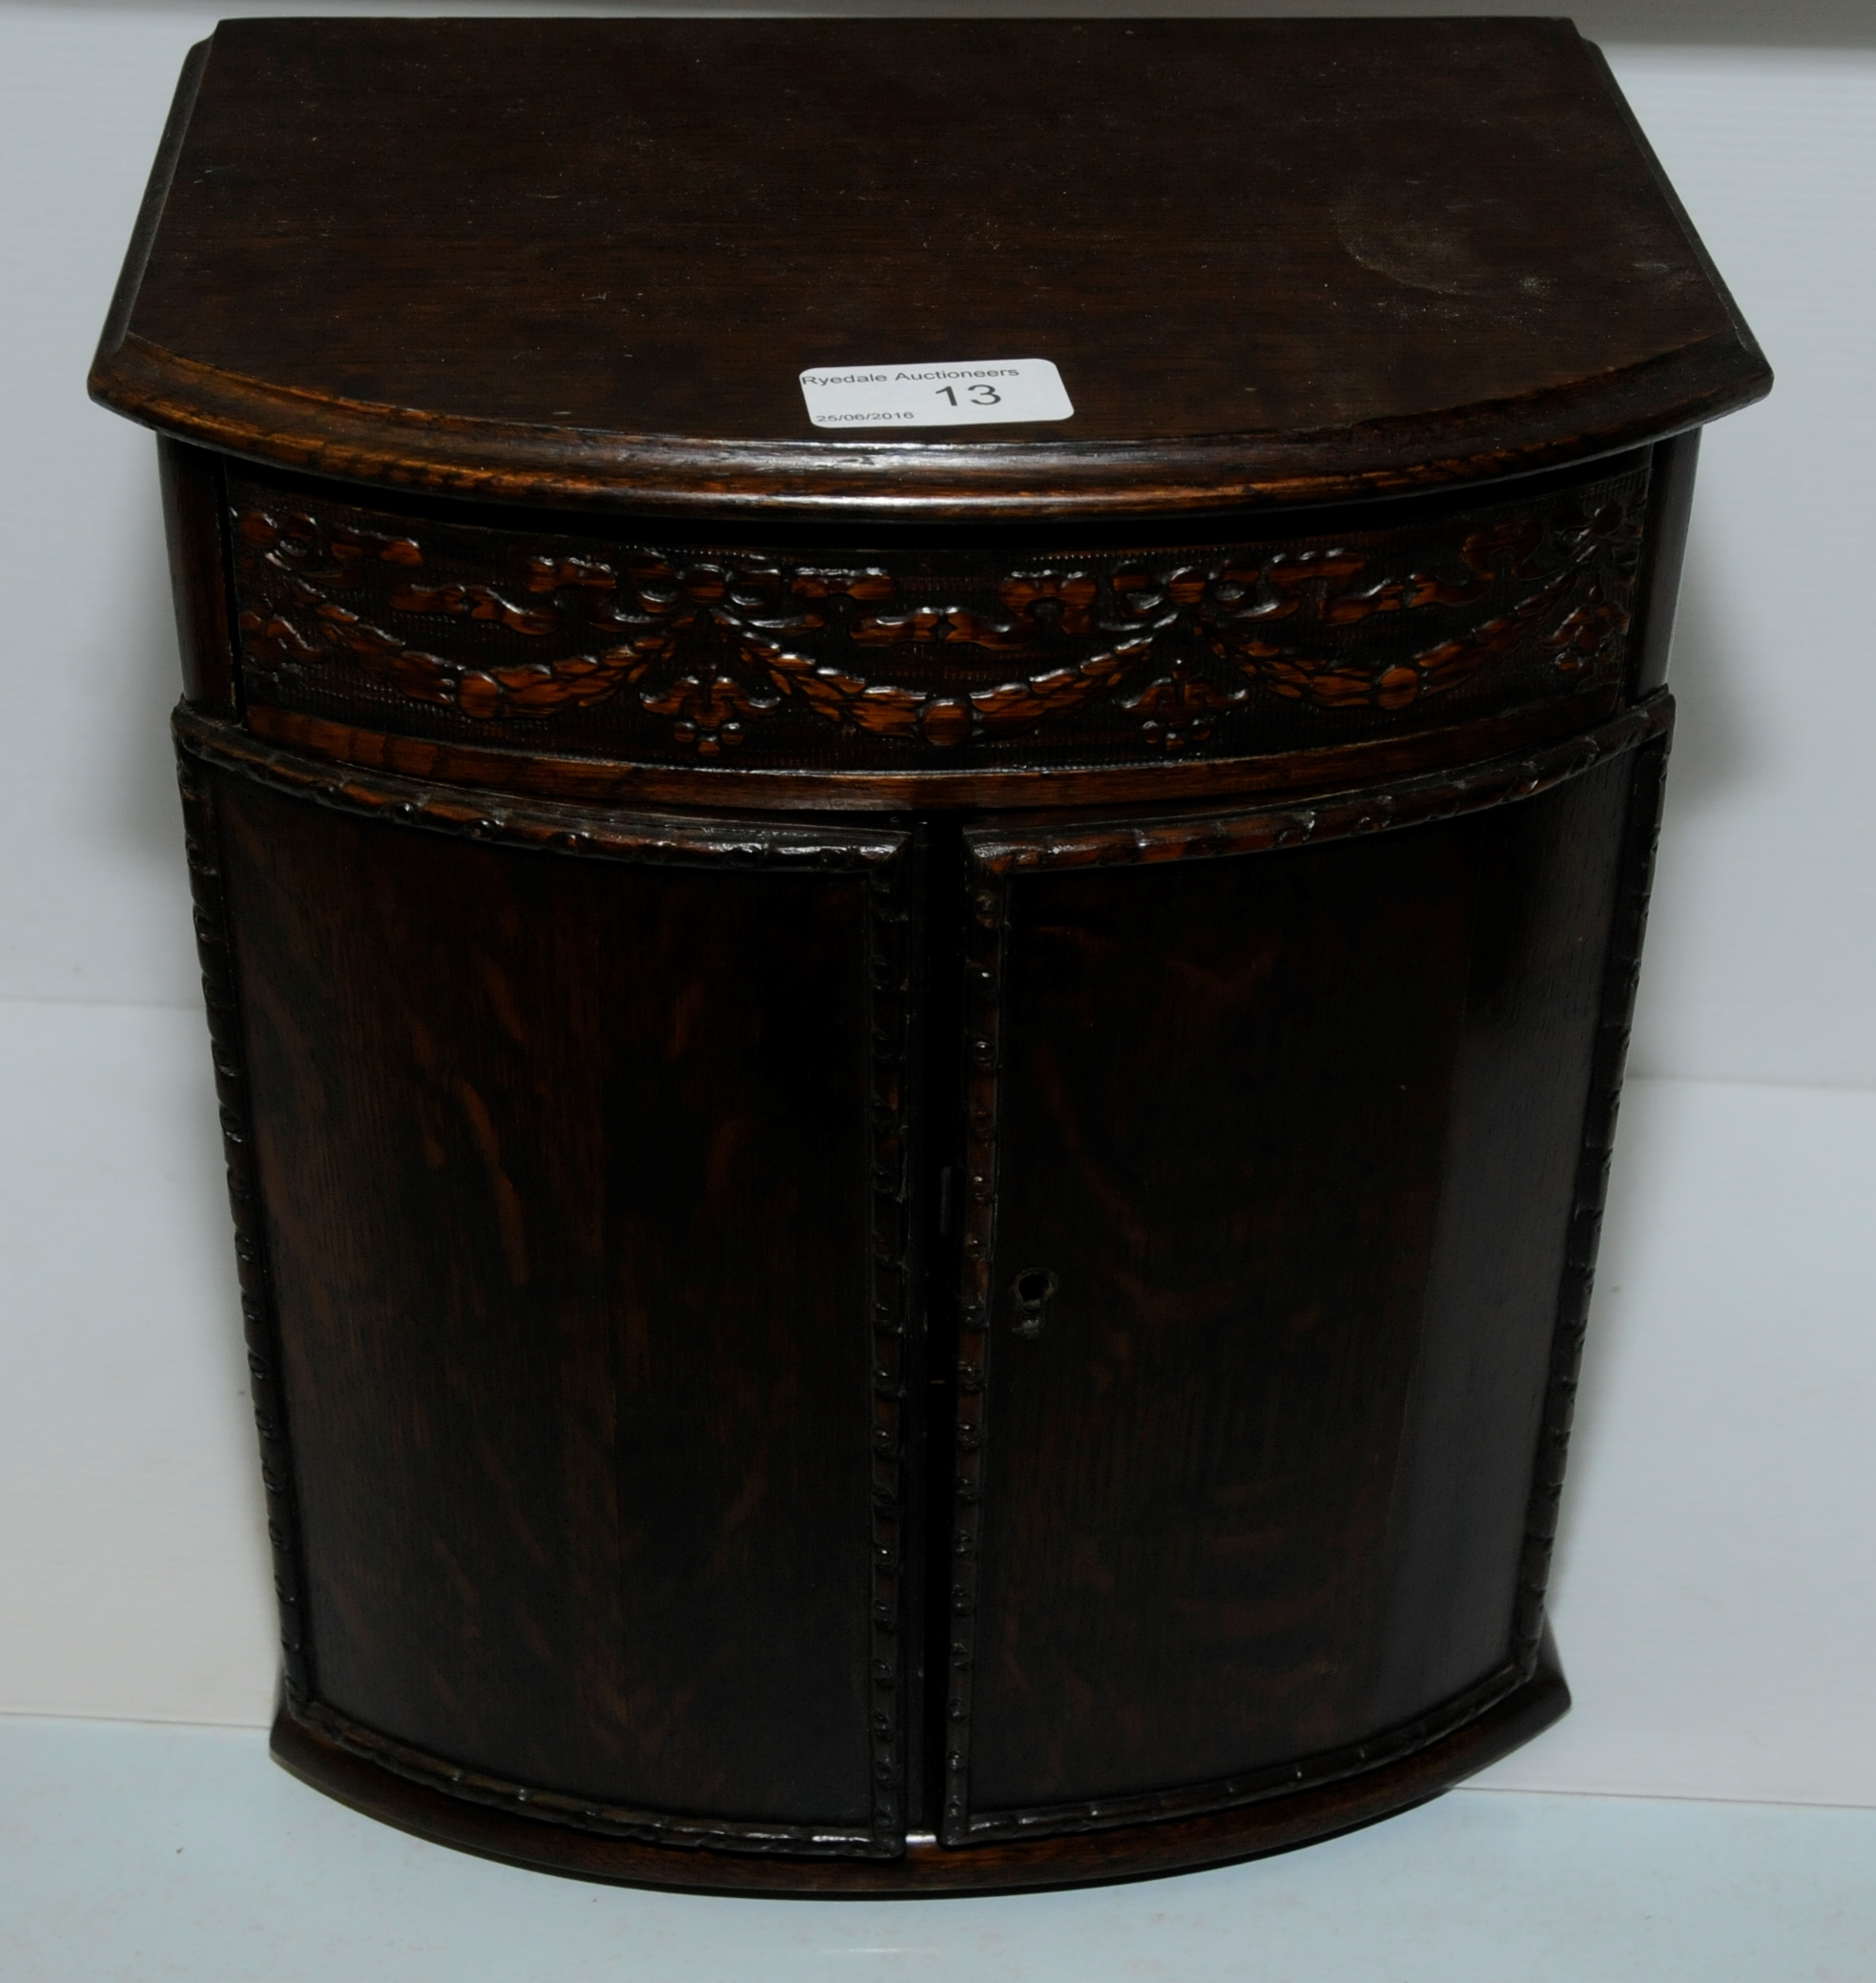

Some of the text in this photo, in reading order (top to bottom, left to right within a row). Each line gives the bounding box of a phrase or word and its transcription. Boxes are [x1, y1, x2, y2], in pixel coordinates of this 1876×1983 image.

[801, 368, 1020, 387] Ryedale Auctioneers
[935, 383, 1001, 407] 13
[815, 411, 915, 423] 25/06/2016
